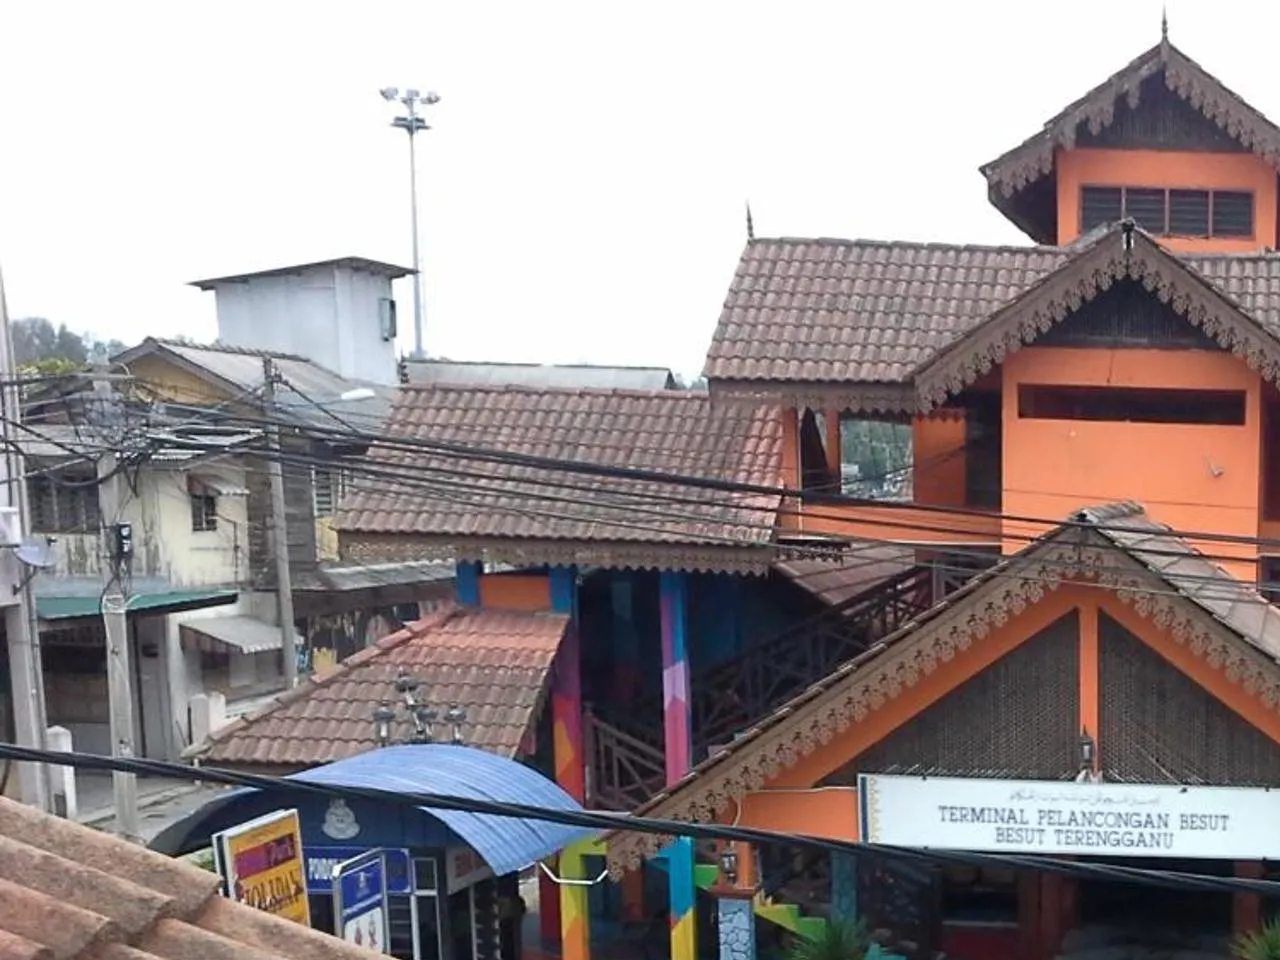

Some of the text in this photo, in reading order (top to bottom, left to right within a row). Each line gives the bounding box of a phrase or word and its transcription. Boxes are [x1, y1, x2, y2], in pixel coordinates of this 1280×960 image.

[938, 805, 1230, 831] TERMINAL PELANCONGAN BESUT
[995, 828, 1174, 849] BESUT TERENGGANU
